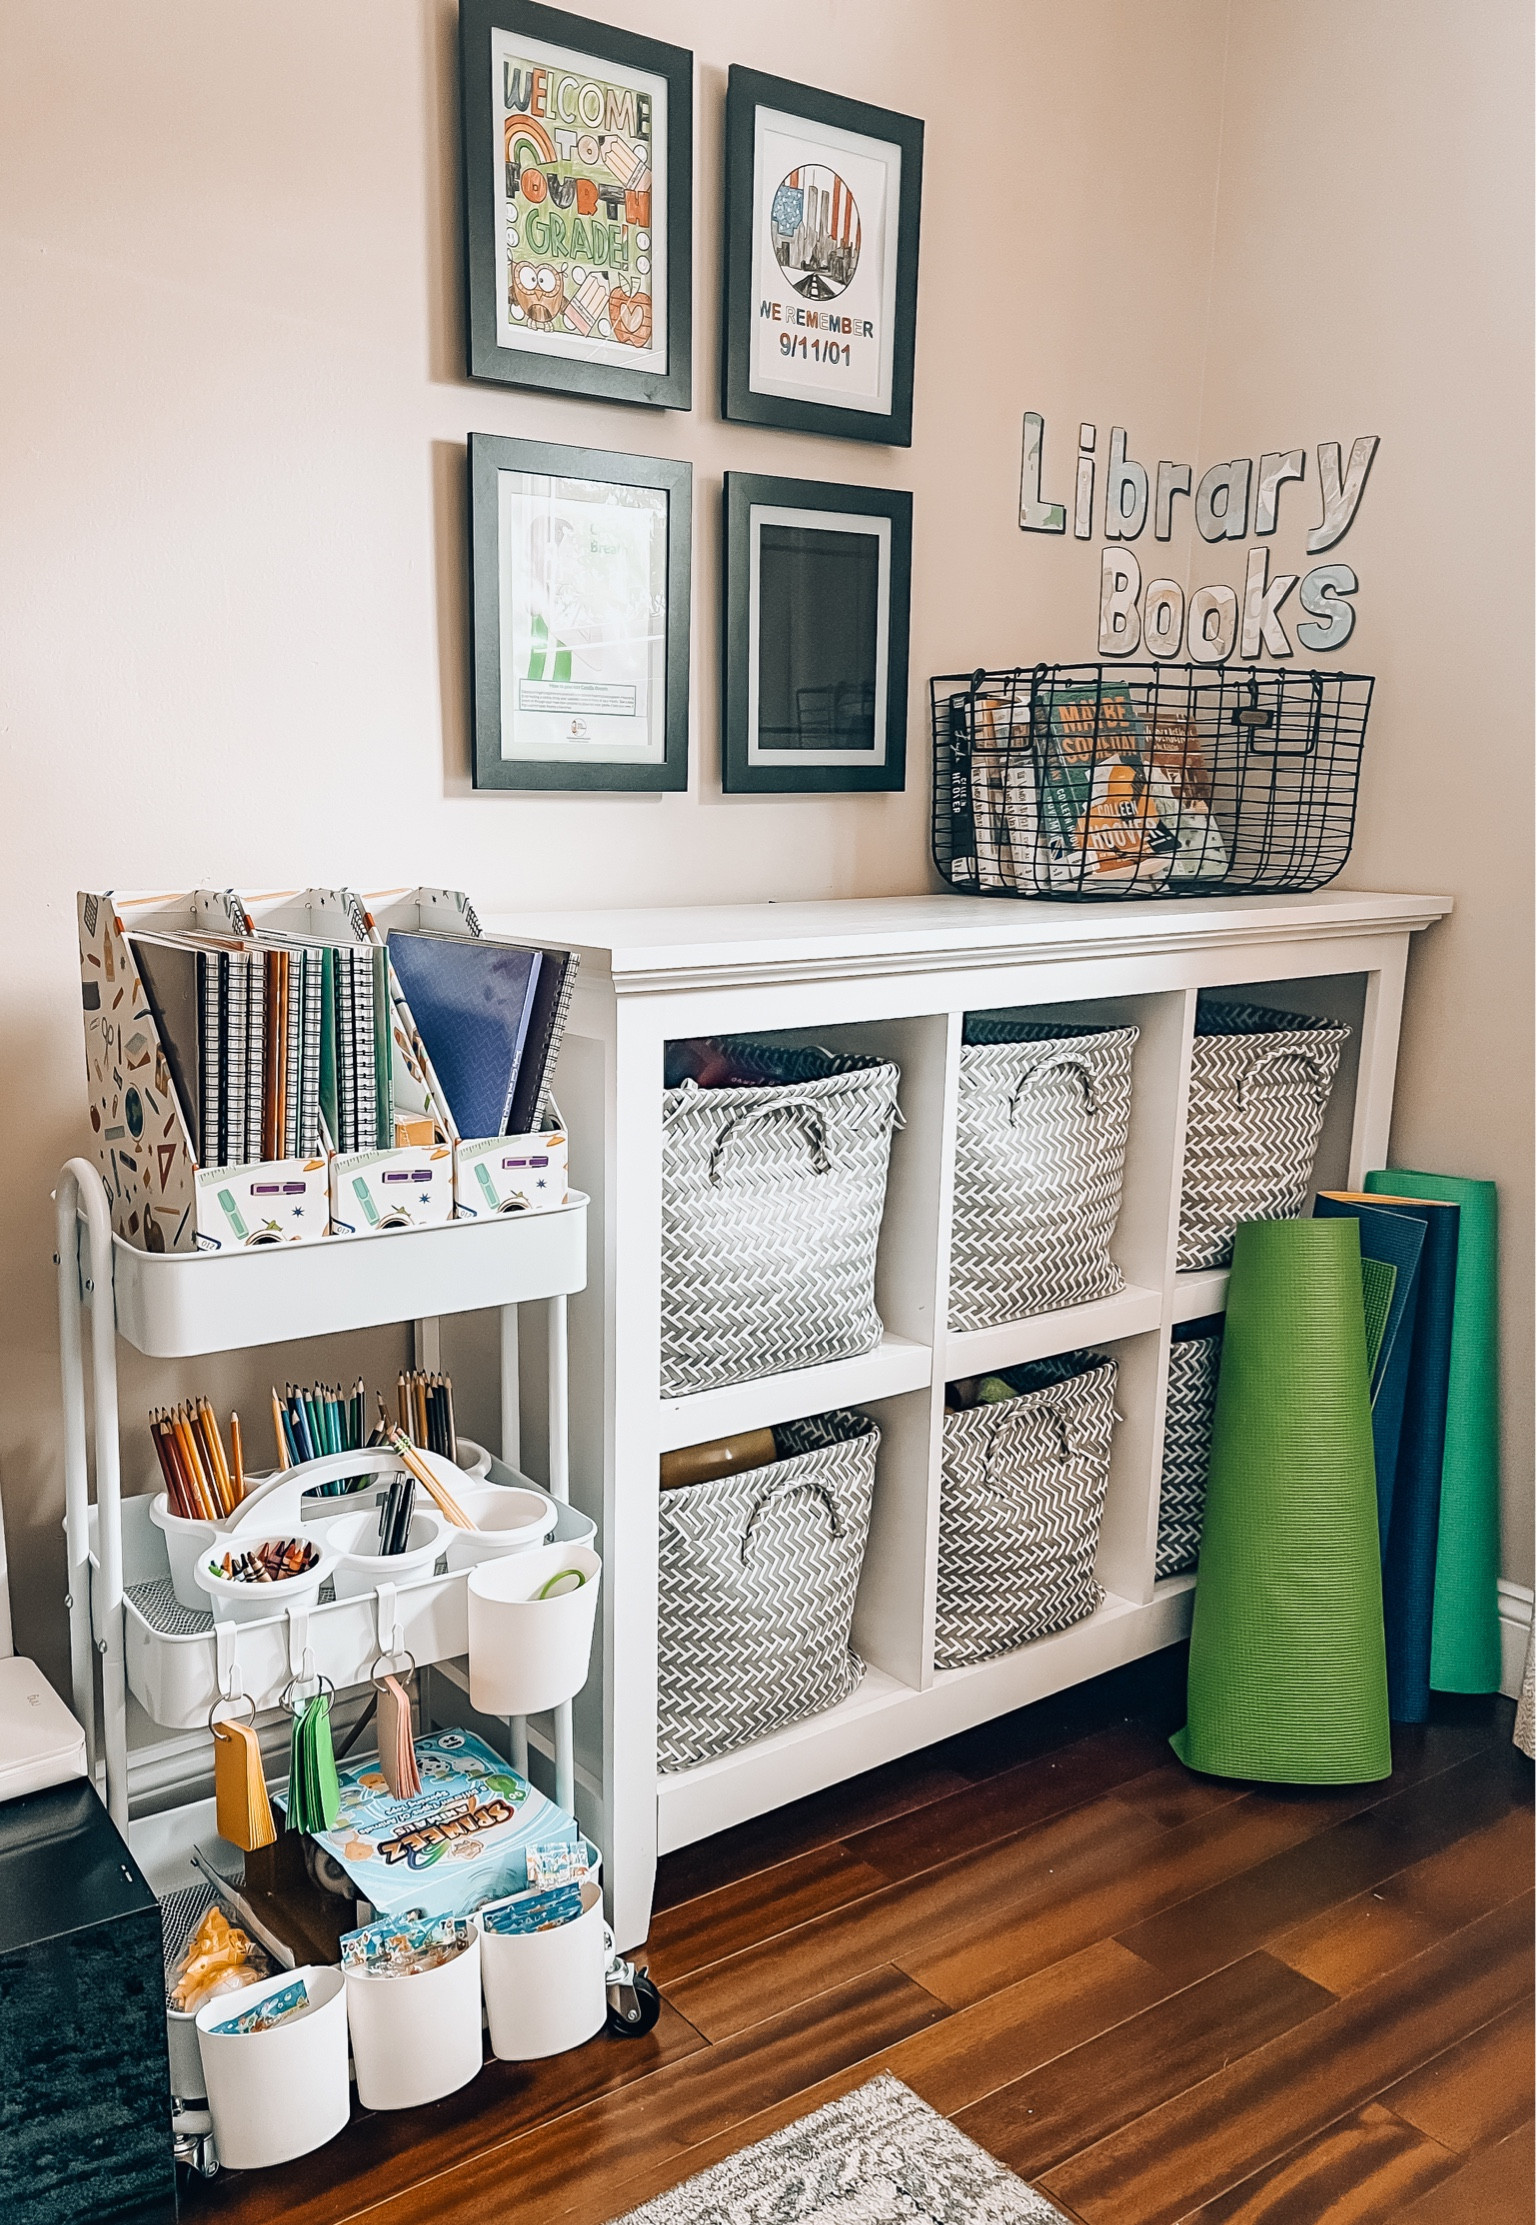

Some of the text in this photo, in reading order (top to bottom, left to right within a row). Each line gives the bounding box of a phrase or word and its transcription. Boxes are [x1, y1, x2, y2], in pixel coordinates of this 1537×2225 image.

[504, 61, 651, 142] WELCOME
[554, 128, 600, 165] TO
[505, 161, 650, 228] FOURTH
[526, 208, 629, 271] GRADE!
[779, 332, 851, 367] 9/11/01
[786, 305, 874, 339] REMEMBER
[1019, 411, 1381, 556] Library
[1098, 545, 1359, 664] Books
[378, 1799, 514, 1864] SPINEEZ
[394, 1803, 469, 1836] ANIMALS
